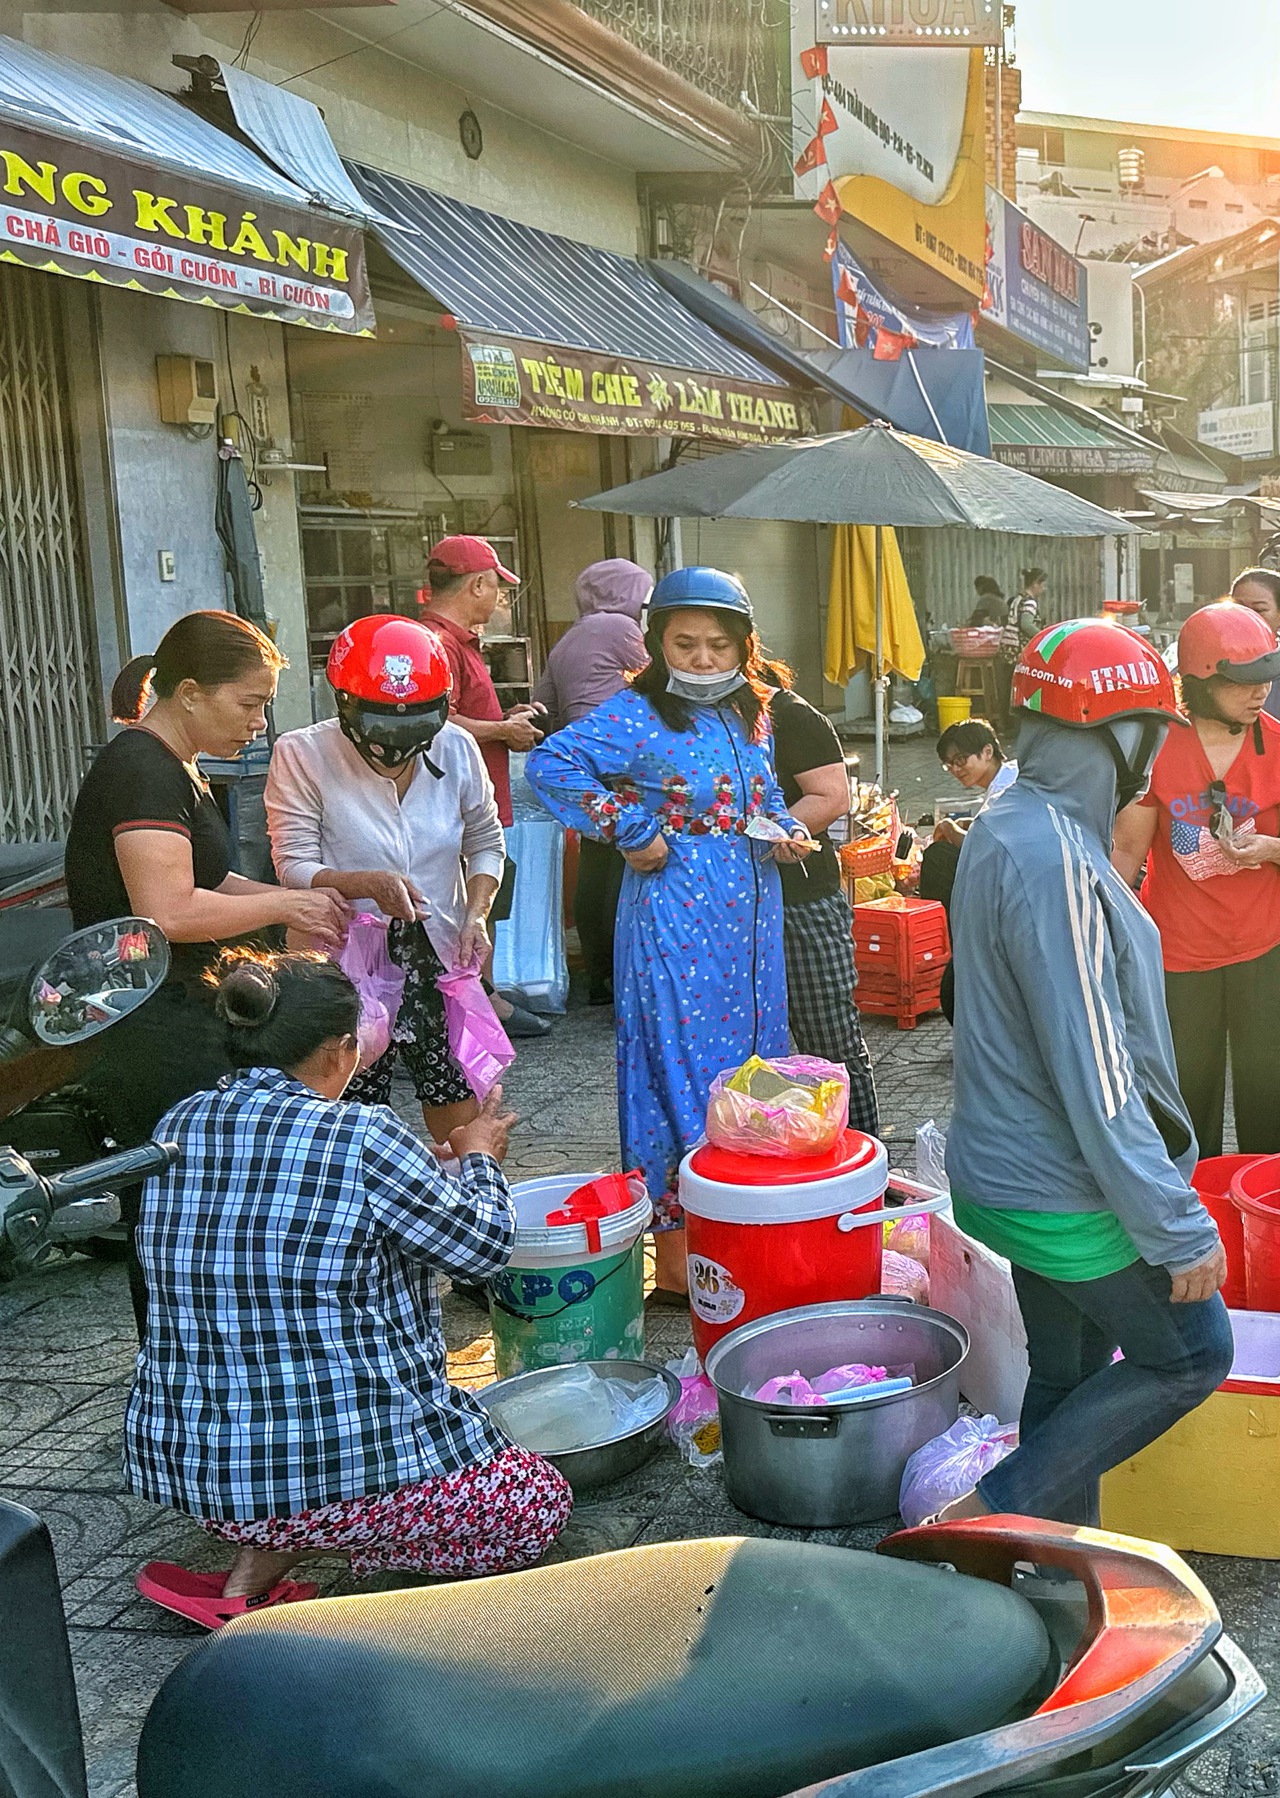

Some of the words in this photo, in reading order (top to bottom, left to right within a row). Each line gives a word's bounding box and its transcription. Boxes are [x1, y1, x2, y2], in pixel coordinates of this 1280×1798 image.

[0, 150, 113, 217] NG
[133, 190, 349, 282] KHÁNH
[6, 214, 60, 247] CHẢ
[68, 230, 111, 259] GIÒ
[134, 246, 174, 273] GỎI
[181, 256, 237, 290] CUỐN
[258, 275, 277, 296] BÌ
[283, 284, 330, 310] CUỐN
[521, 355, 585, 406] TIỆM
[591, 366, 642, 407] CHÈ
[1090, 660, 1160, 695] ITALIA
